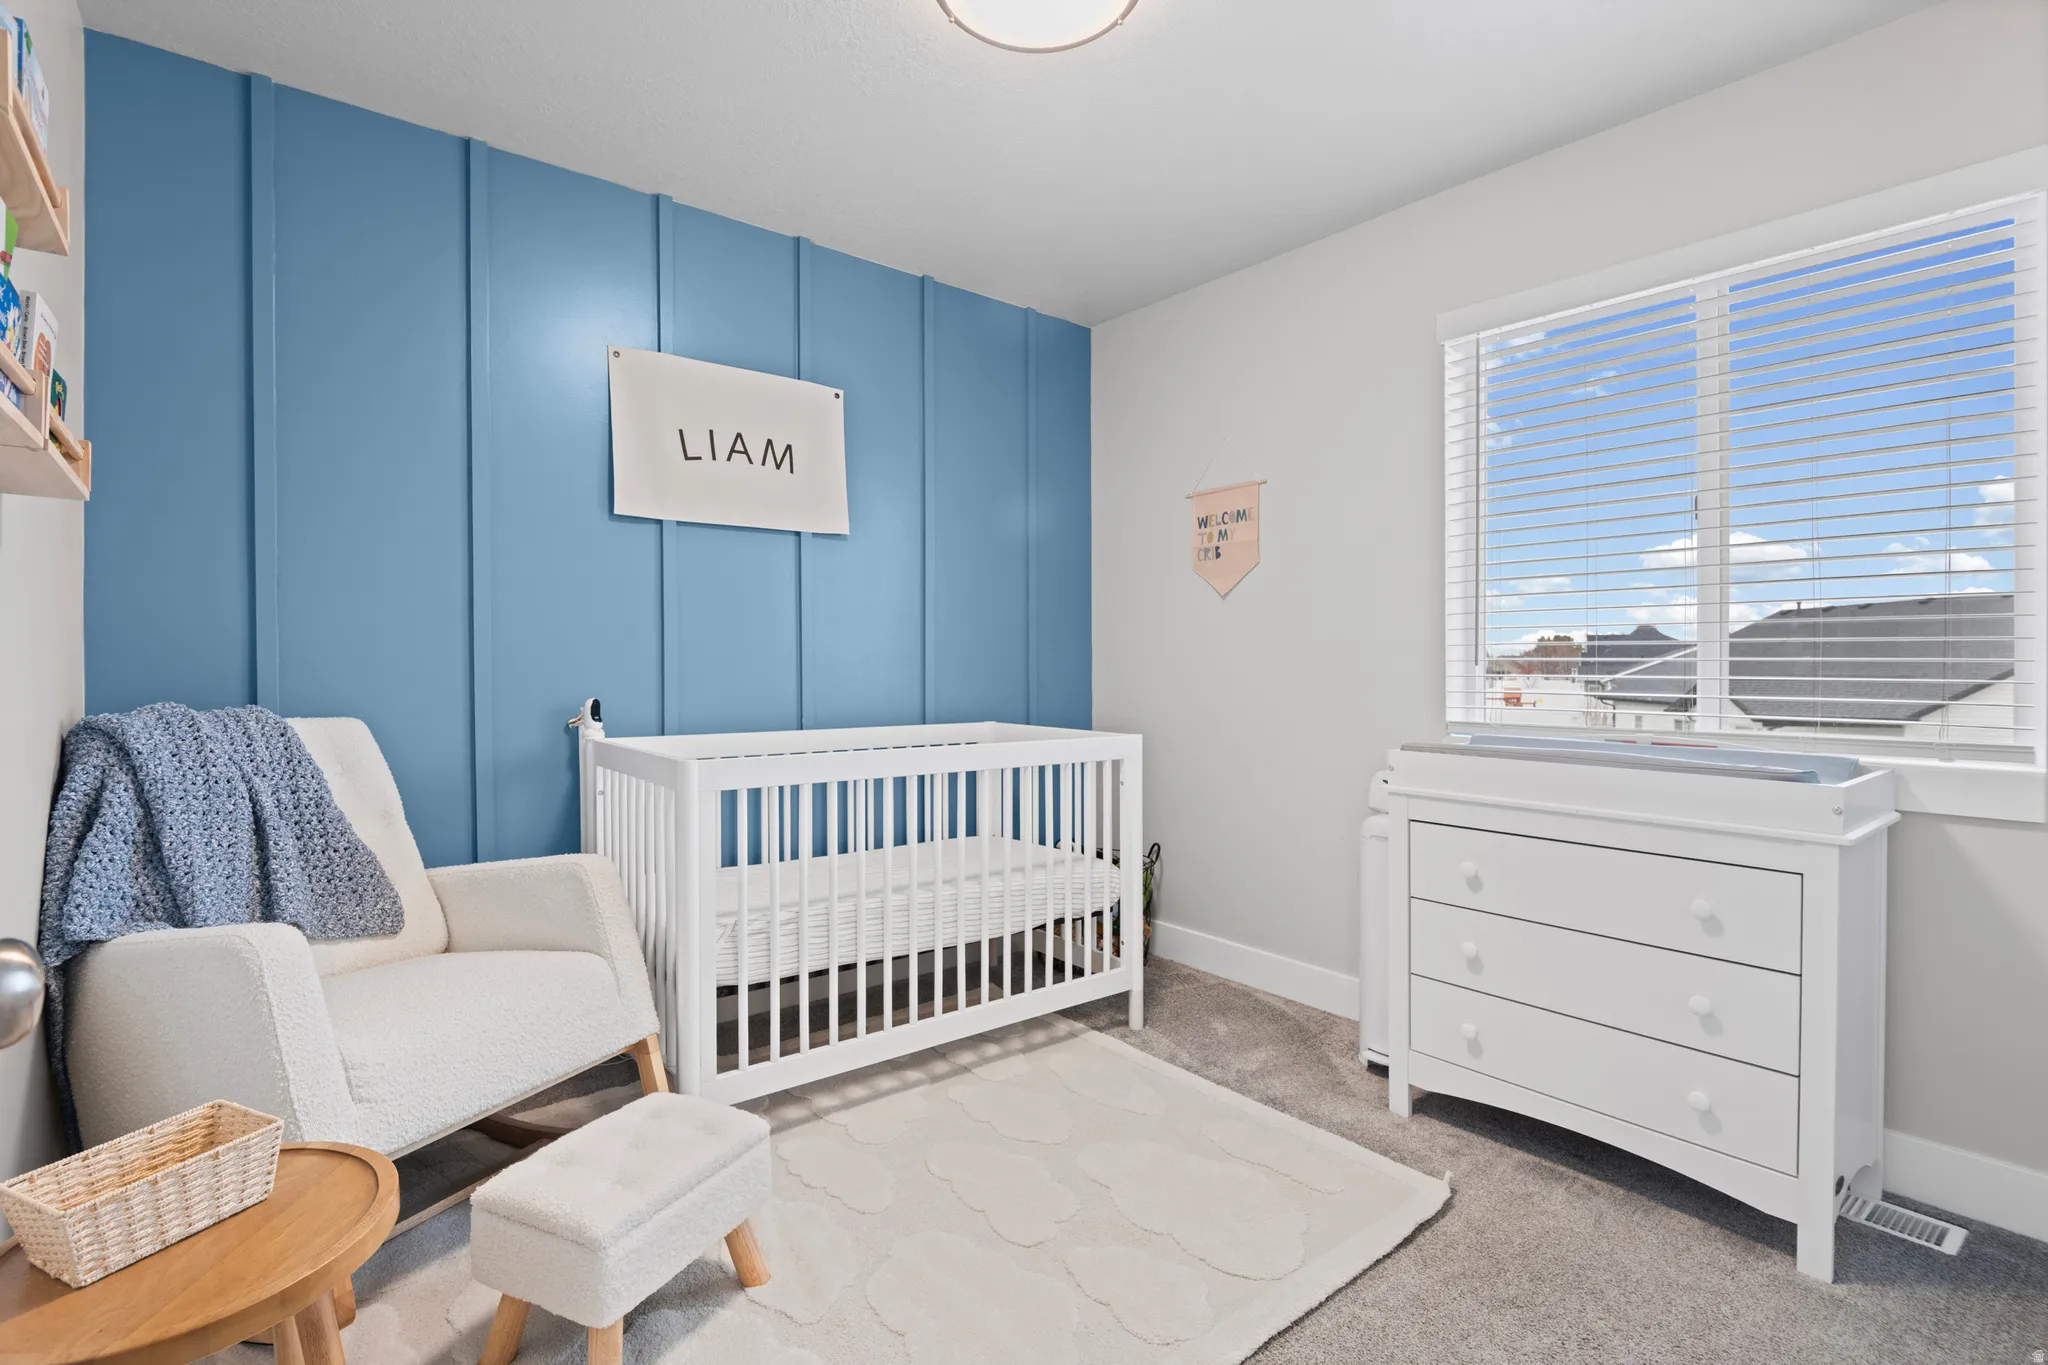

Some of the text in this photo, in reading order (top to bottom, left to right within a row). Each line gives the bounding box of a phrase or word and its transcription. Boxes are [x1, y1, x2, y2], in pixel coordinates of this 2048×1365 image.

[678, 429, 794, 474] LIAM
[1197, 507, 1255, 530] WELCOME
[1197, 528, 1236, 545] TO MY
[1197, 546, 1222, 562] CRIB
